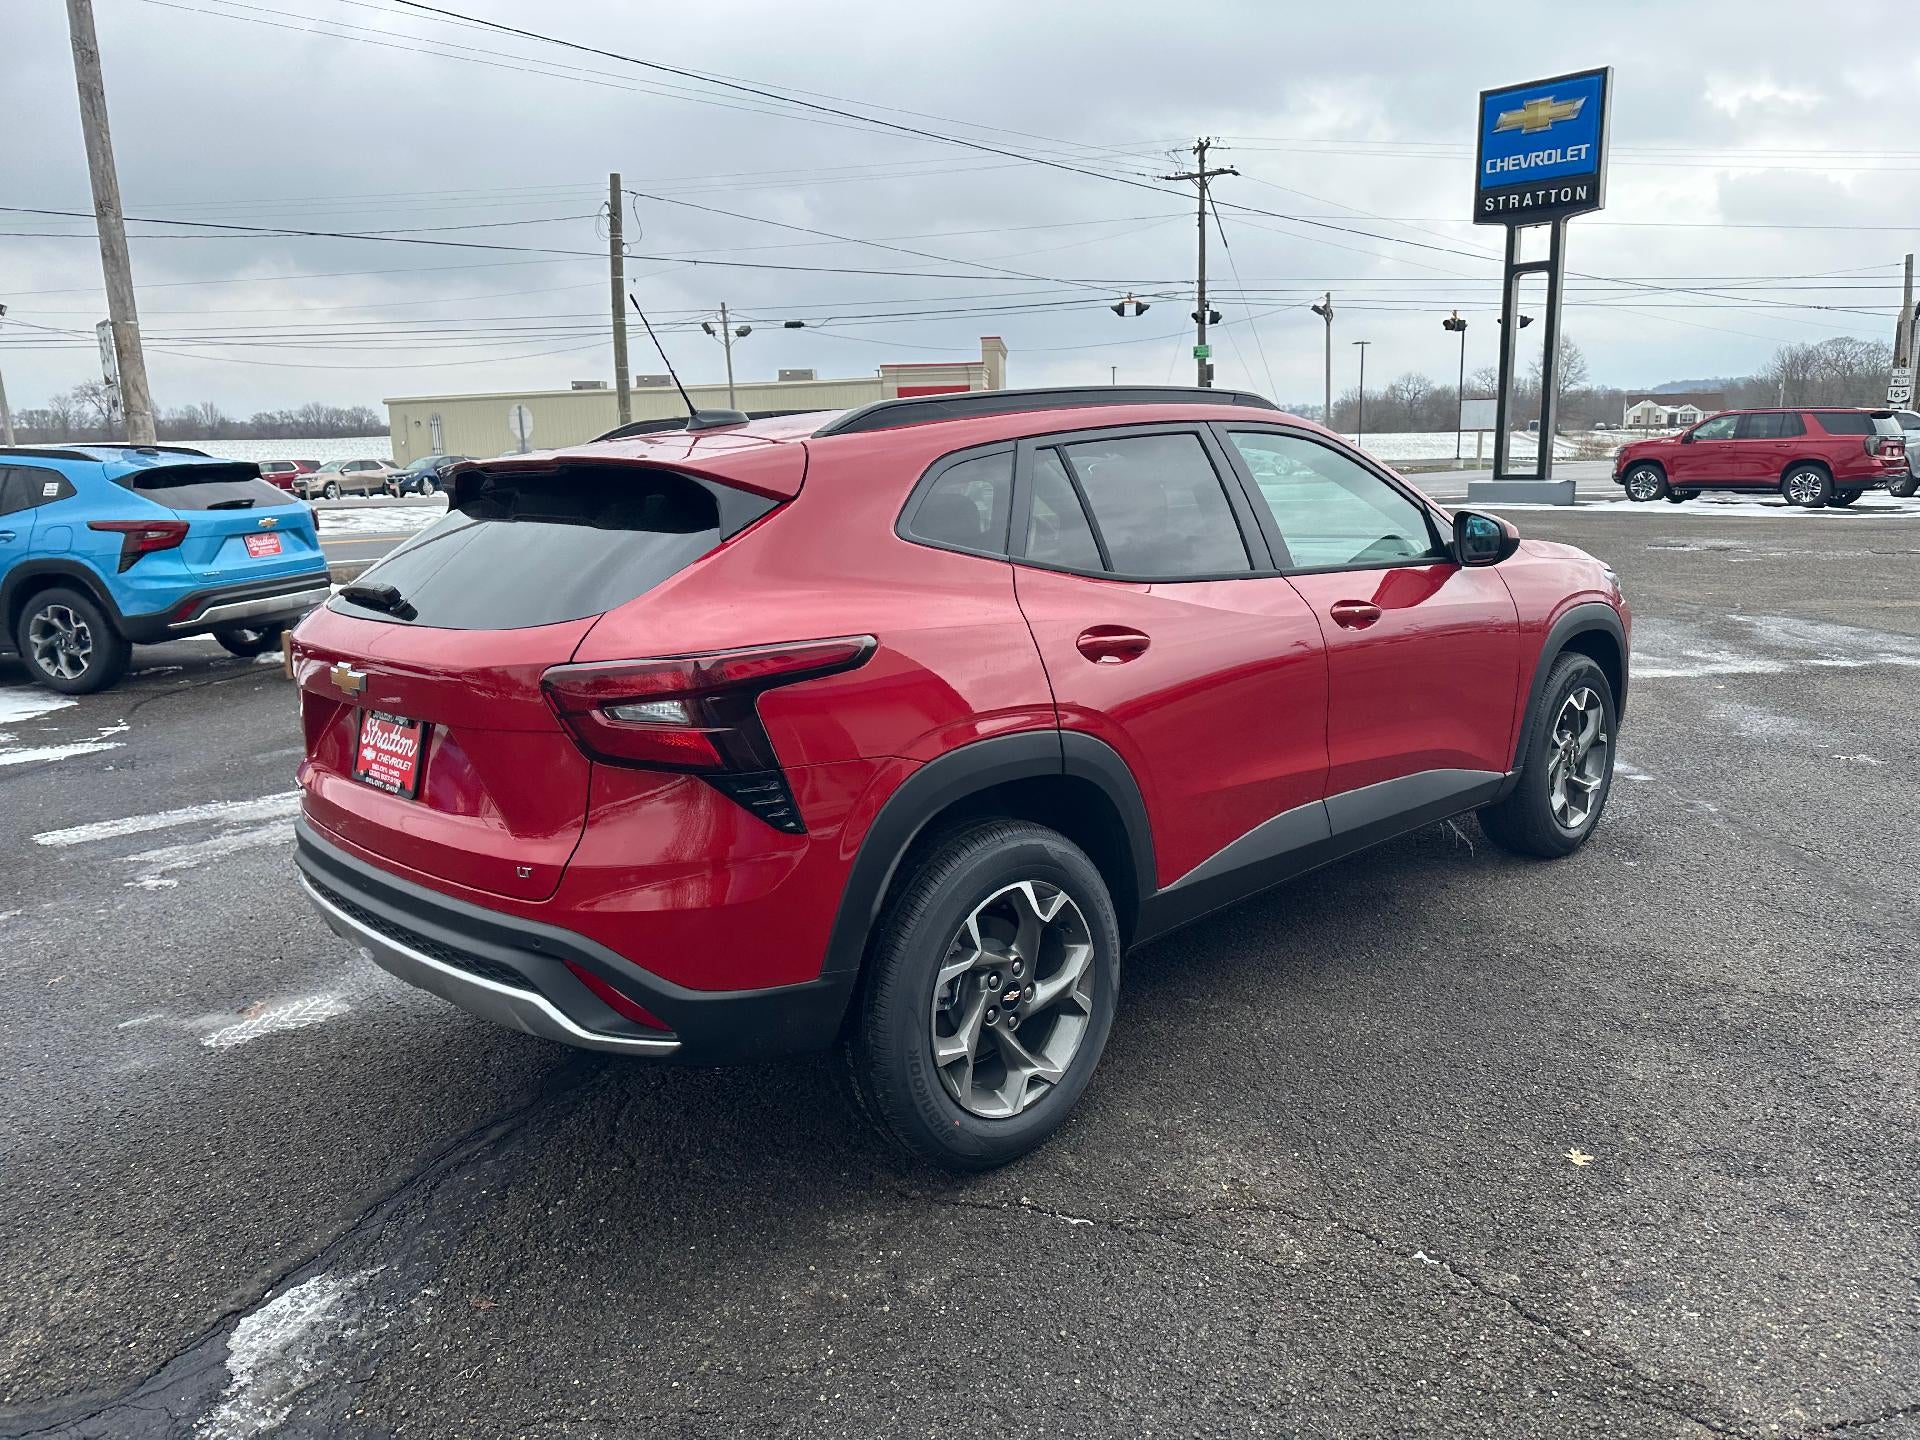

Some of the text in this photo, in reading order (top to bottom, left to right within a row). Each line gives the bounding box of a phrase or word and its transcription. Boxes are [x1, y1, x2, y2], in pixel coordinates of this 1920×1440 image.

[1486, 144, 1590, 173] CHEVROLET
[1485, 186, 1588, 211] STRATTON
[1890, 389, 1907, 399] 165
[249, 536, 278, 547] Stratton
[362, 717, 418, 757] Stratton
[377, 753, 412, 771] CHEVROLET
[516, 866, 532, 878] LT
